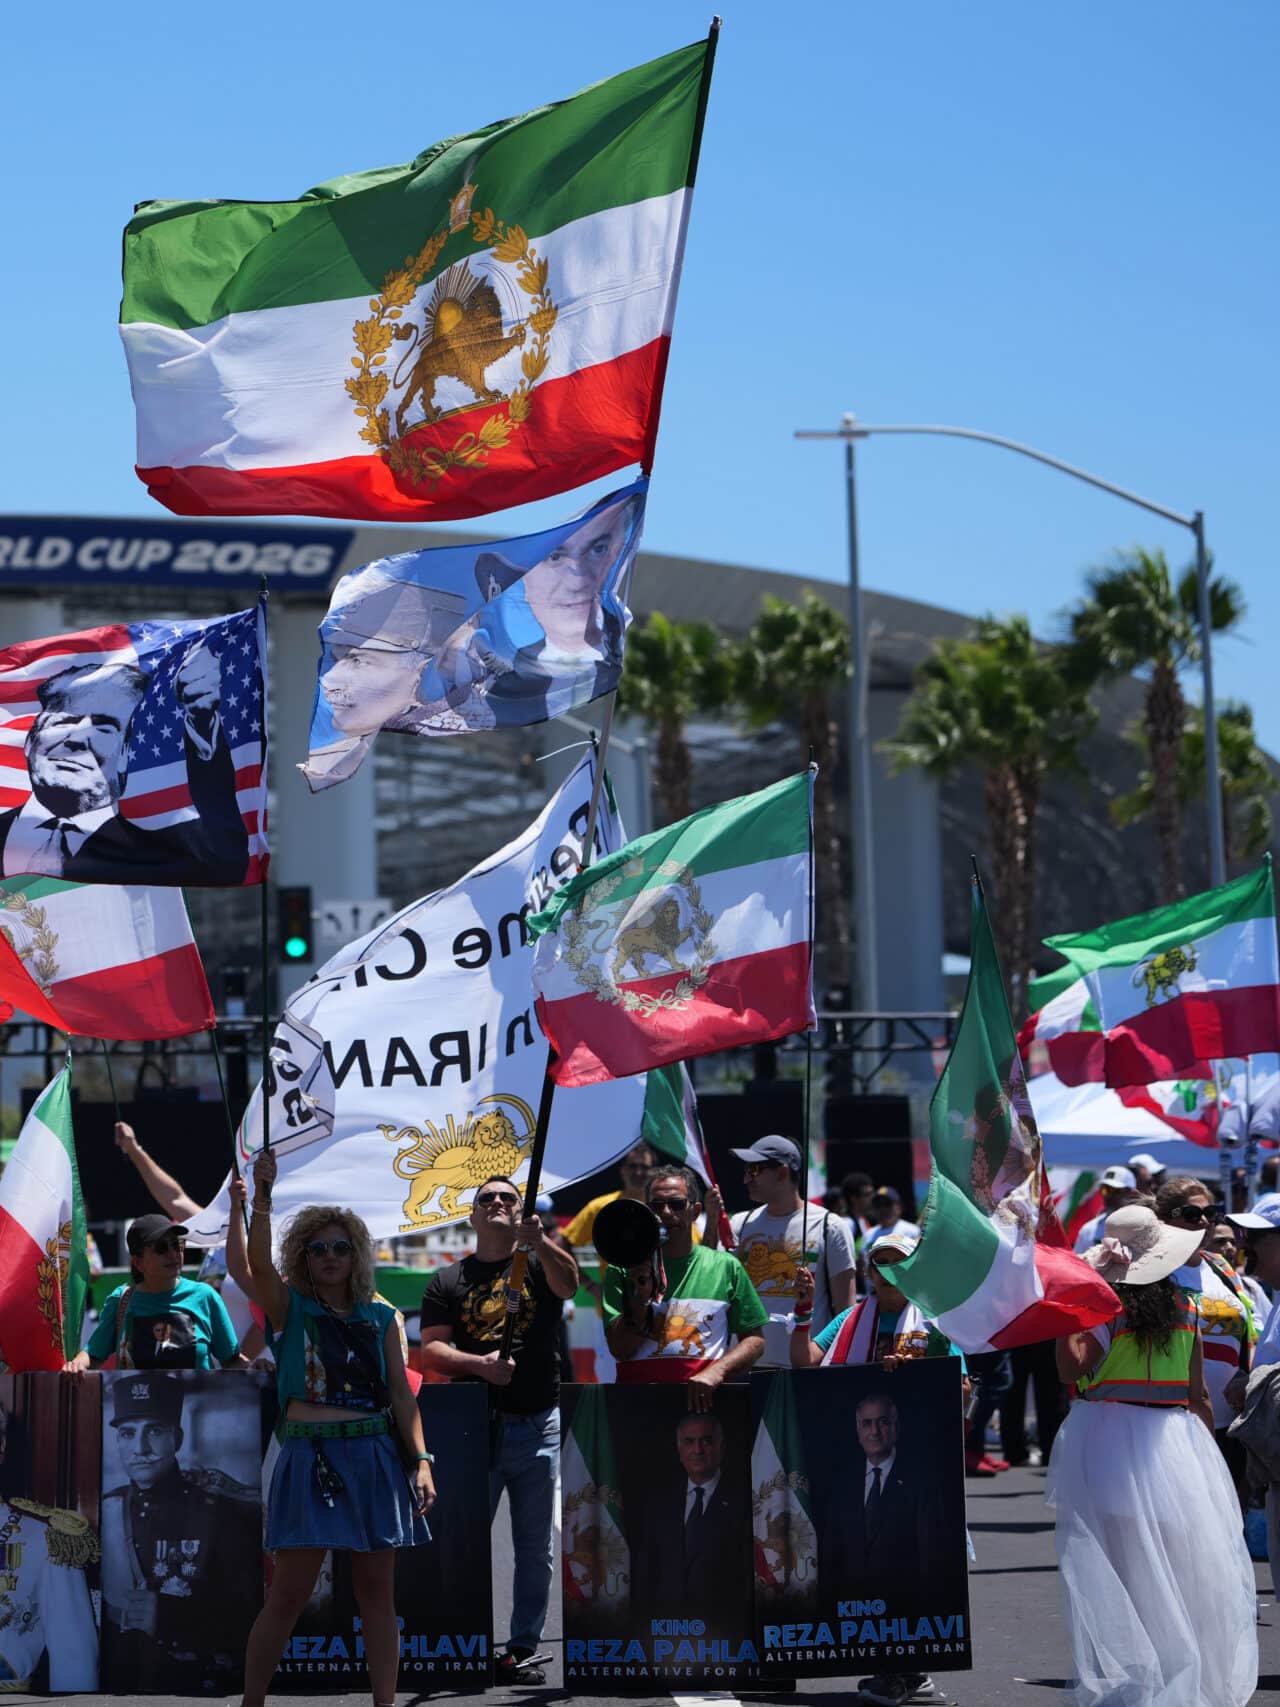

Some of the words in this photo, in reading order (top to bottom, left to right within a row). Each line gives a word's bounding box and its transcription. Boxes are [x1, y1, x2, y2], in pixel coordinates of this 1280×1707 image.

[76, 537, 172, 572] CUP
[172, 540, 334, 576] 2026
[837, 1598, 887, 1618] KING
[651, 1619, 705, 1636] KING
[763, 1622, 836, 1649] REZA
[840, 1614, 964, 1645] PAHLAVI
[567, 1639, 648, 1663] REZA
[653, 1639, 760, 1663] PAHLA
[765, 1646, 877, 1663] ALTERNATIVE
[886, 1645, 917, 1657] FOR
[925, 1642, 965, 1655] IRAN
[275, 1662, 369, 1673] ALTERNATI
[403, 1661, 435, 1672] FOR
[445, 1661, 487, 1672] IRAN
[568, 1666, 694, 1677] ALTERNATIVE
[703, 1666, 737, 1677] FOR
